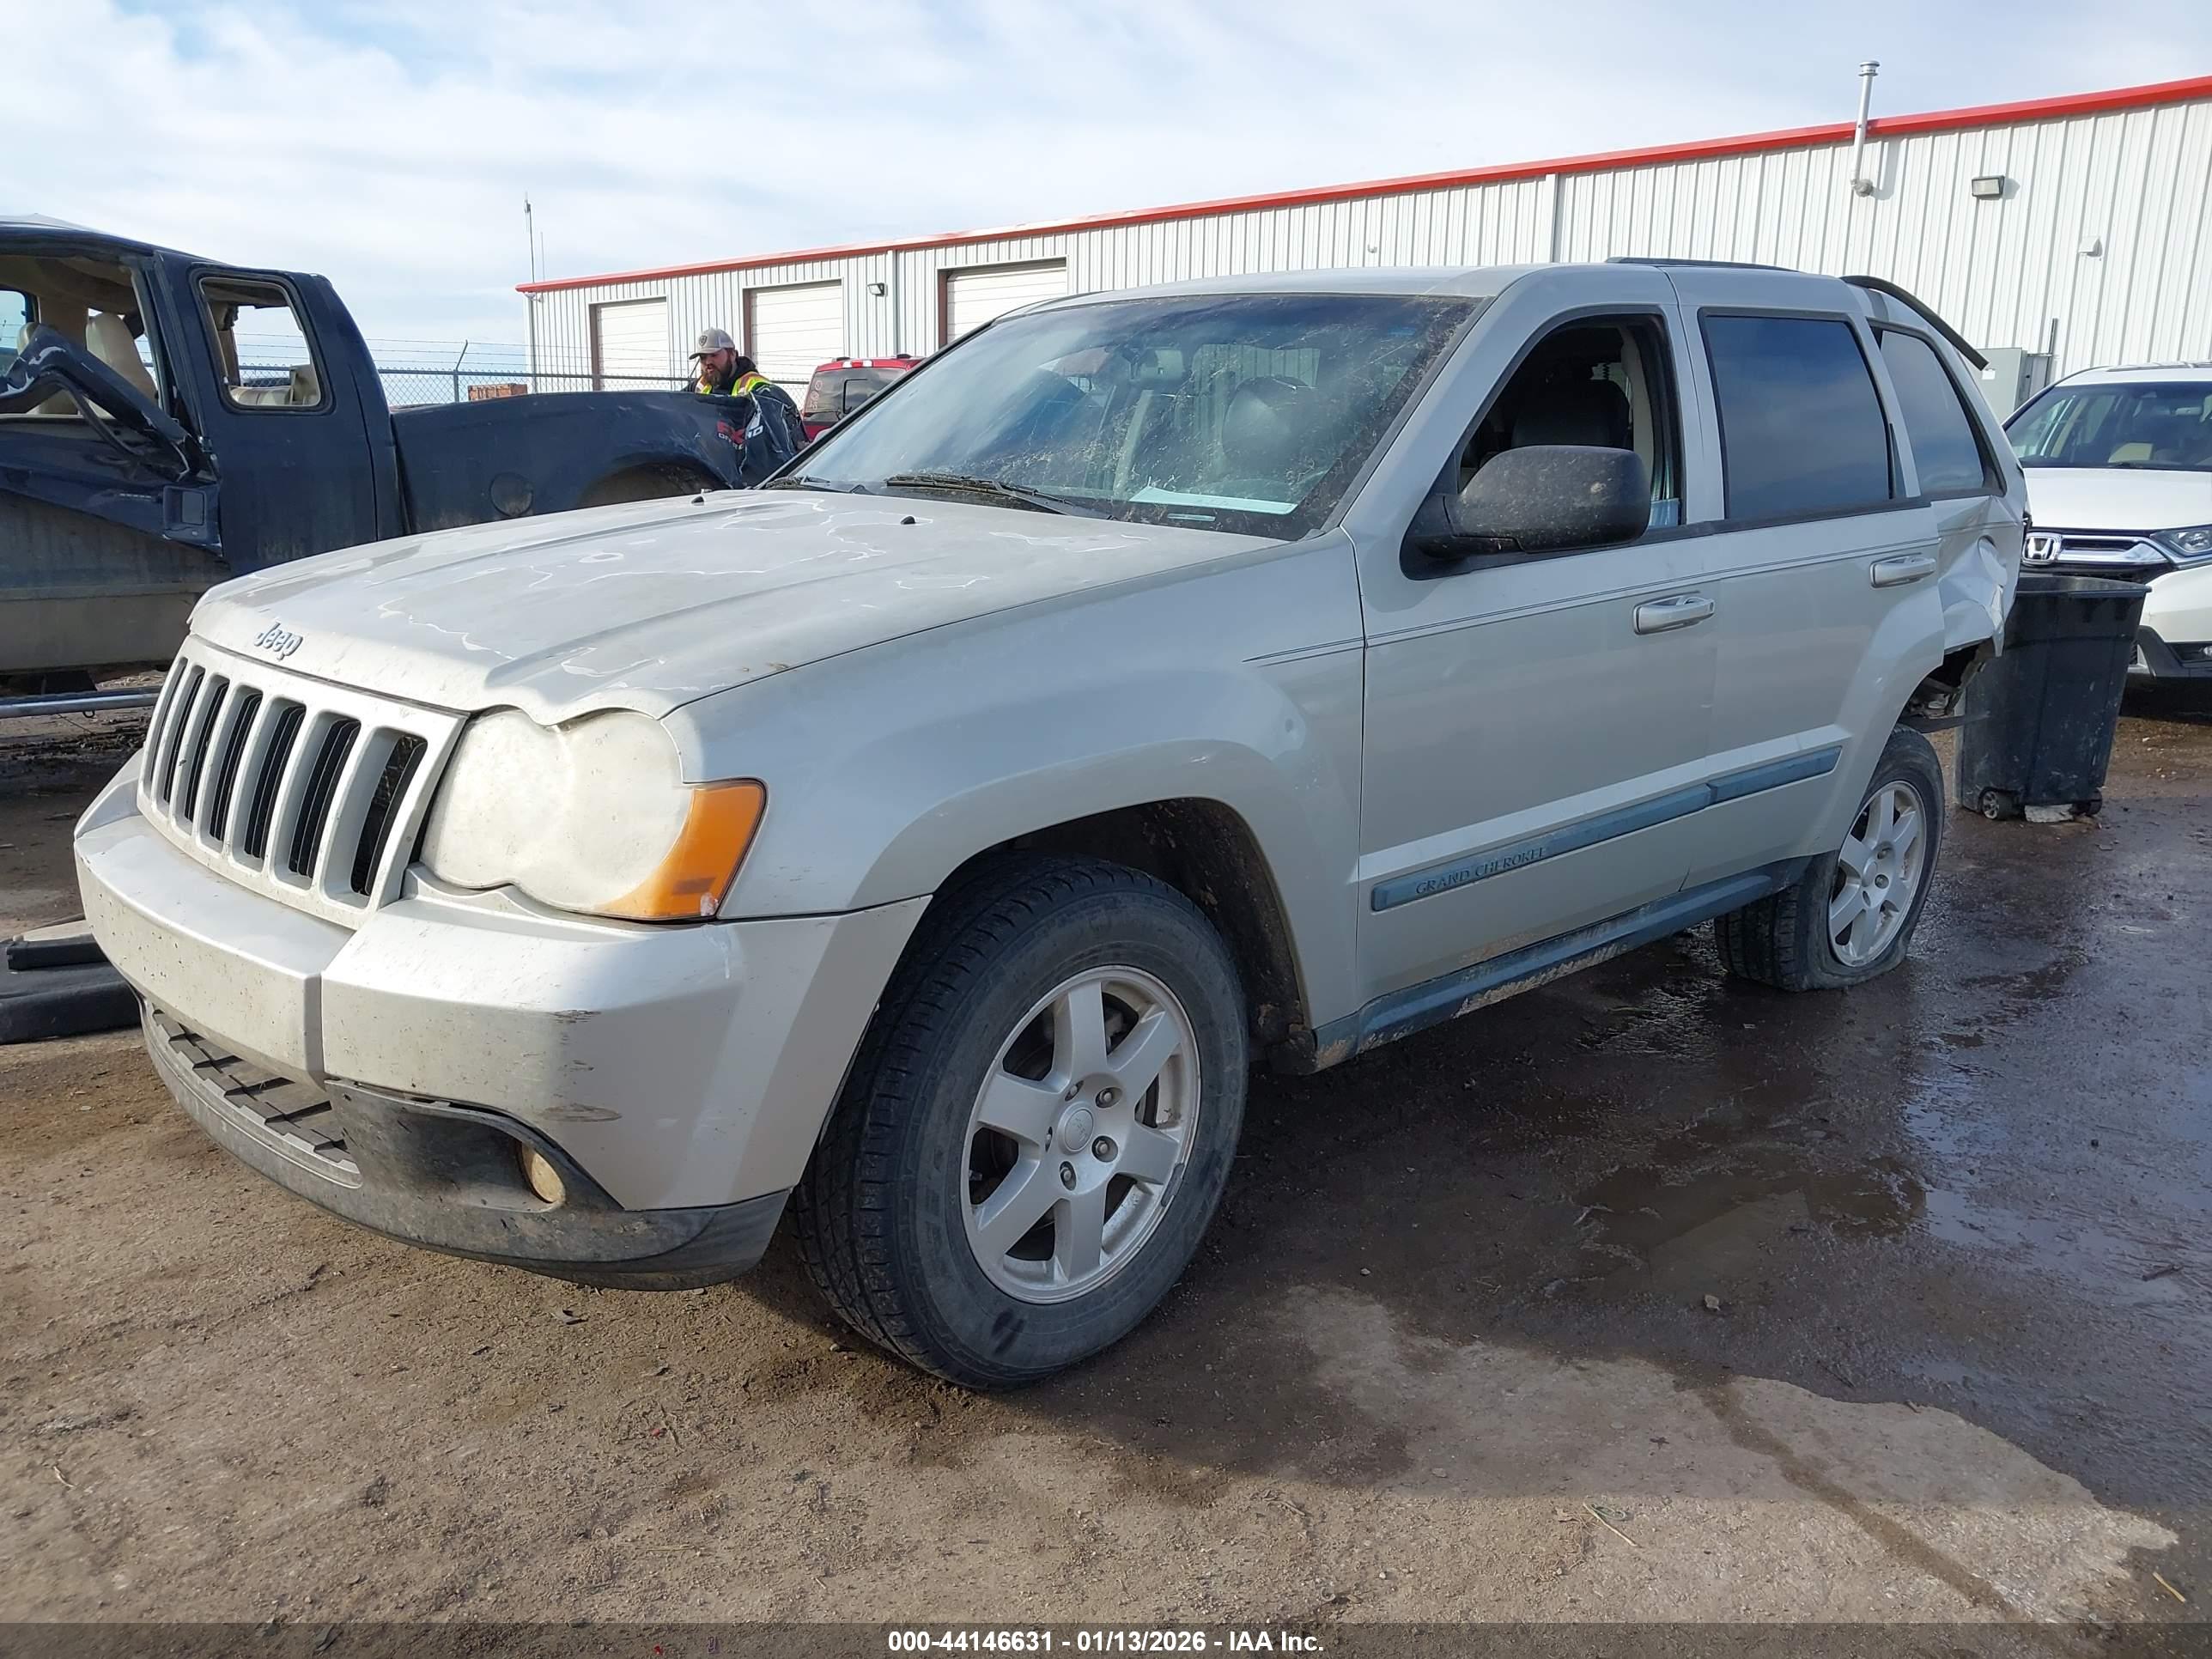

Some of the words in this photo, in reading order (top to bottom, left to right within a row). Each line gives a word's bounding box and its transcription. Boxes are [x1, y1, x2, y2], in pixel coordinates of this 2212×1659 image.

[253, 621, 303, 661] Jeep
[1416, 869, 1469, 895] GRAND
[1474, 846, 1545, 877] CHEROKEE
